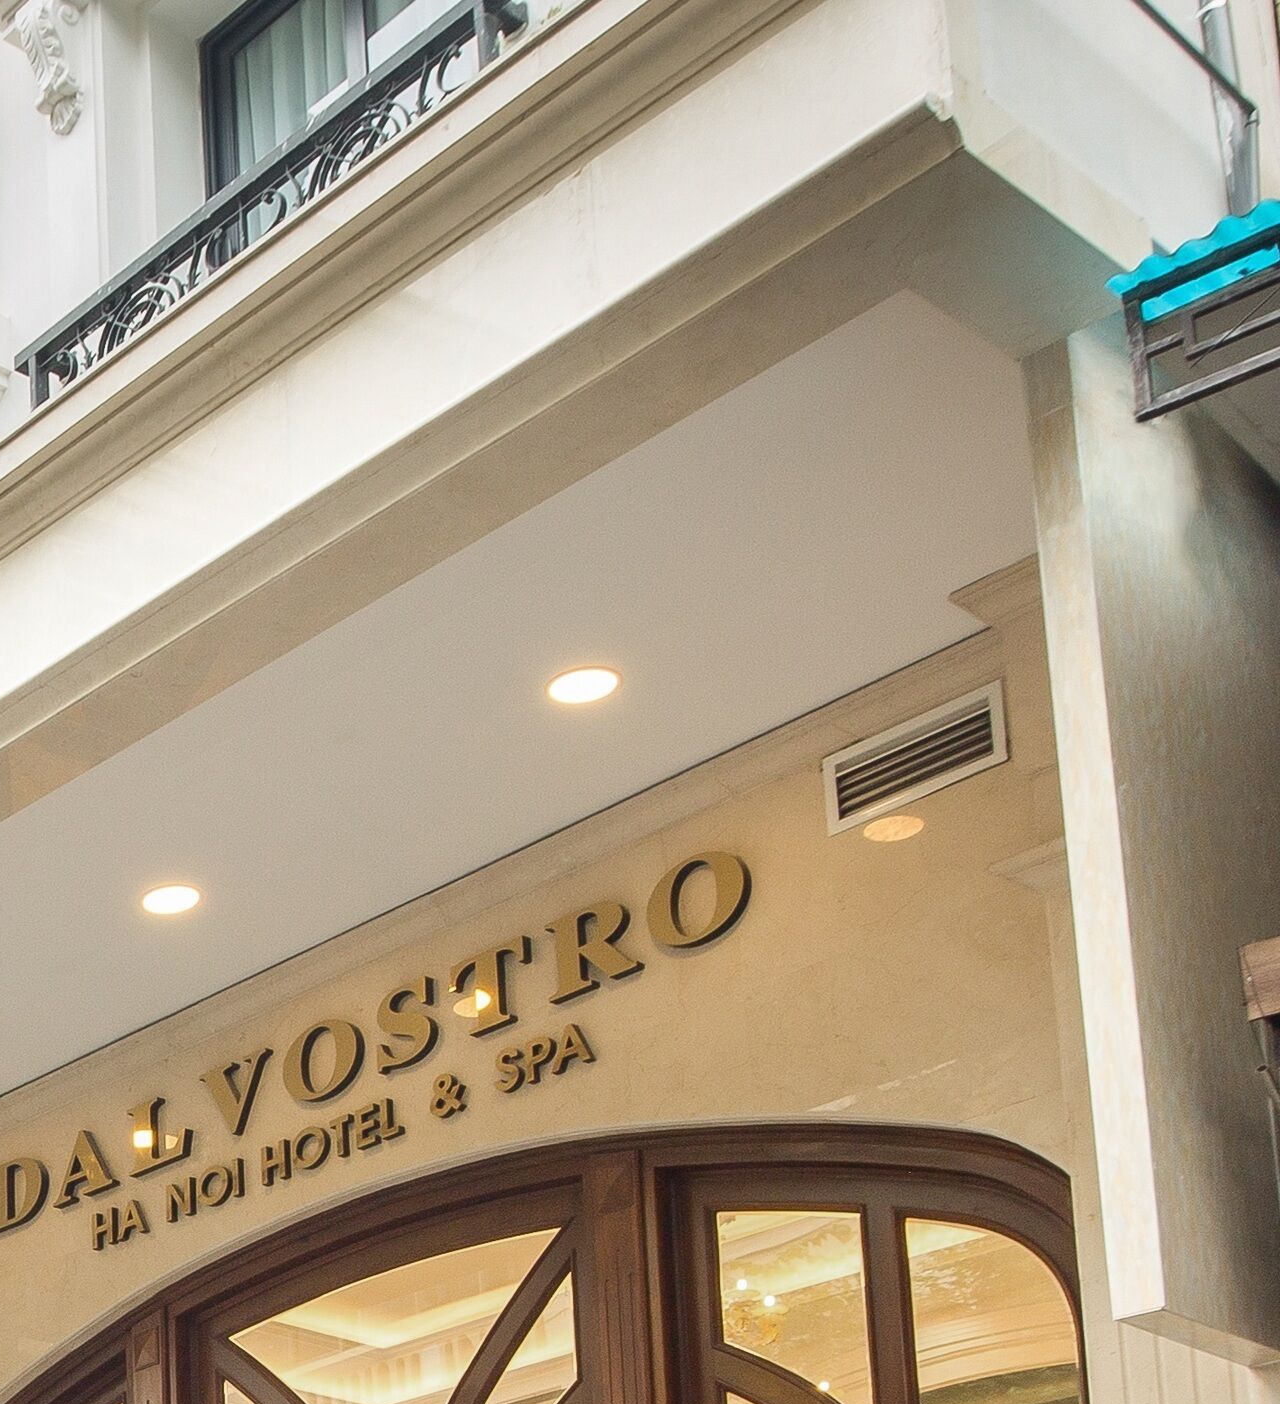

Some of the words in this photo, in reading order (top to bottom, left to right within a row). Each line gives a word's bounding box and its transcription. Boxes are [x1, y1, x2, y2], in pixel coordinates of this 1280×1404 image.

[91, 1197, 151, 1252] HA
[166, 1158, 245, 1225] NOI
[261, 1099, 406, 1189] HOTEL
[429, 1072, 468, 1120] &
[496, 1024, 596, 1095] SPA
